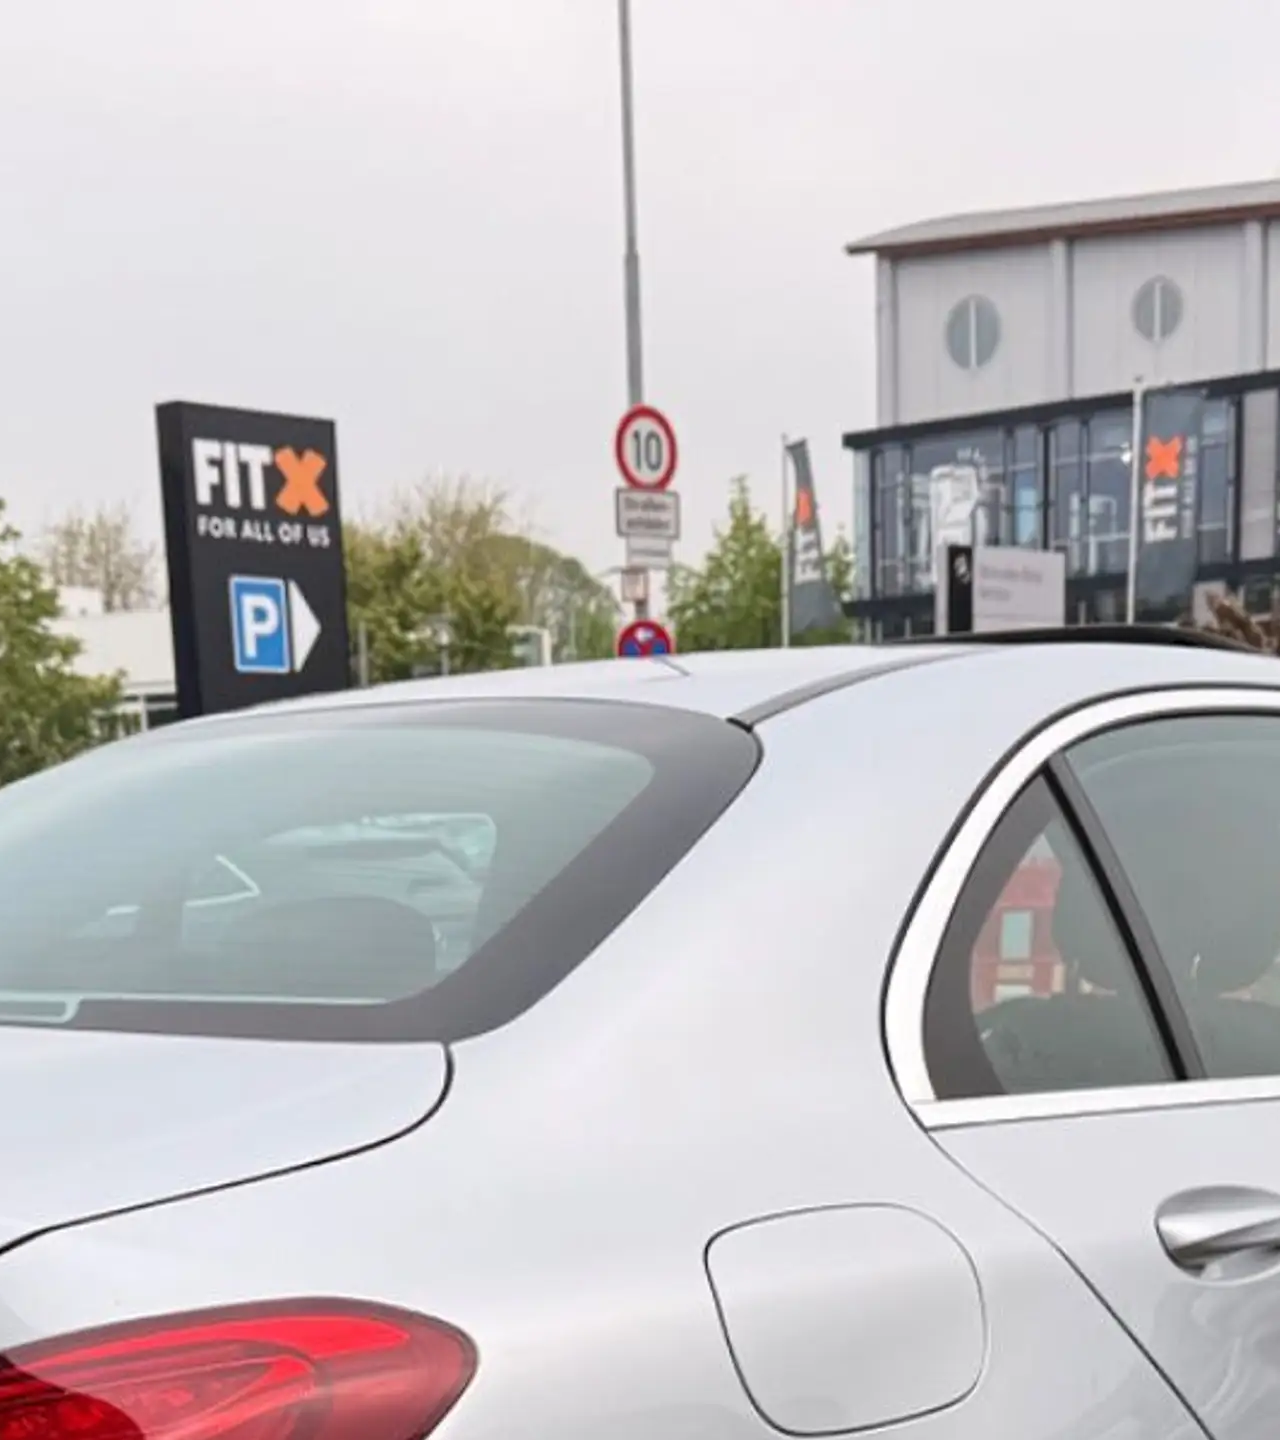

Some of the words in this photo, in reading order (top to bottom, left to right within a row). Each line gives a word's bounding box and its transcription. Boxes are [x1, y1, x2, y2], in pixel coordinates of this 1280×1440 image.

[192, 437, 330, 517] FITX
[633, 429, 663, 472] 10
[197, 514, 237, 539] FOR
[240, 519, 274, 543] ALL
[278, 521, 303, 545] OF
[307, 524, 331, 549] US
[240, 593, 280, 659] P
